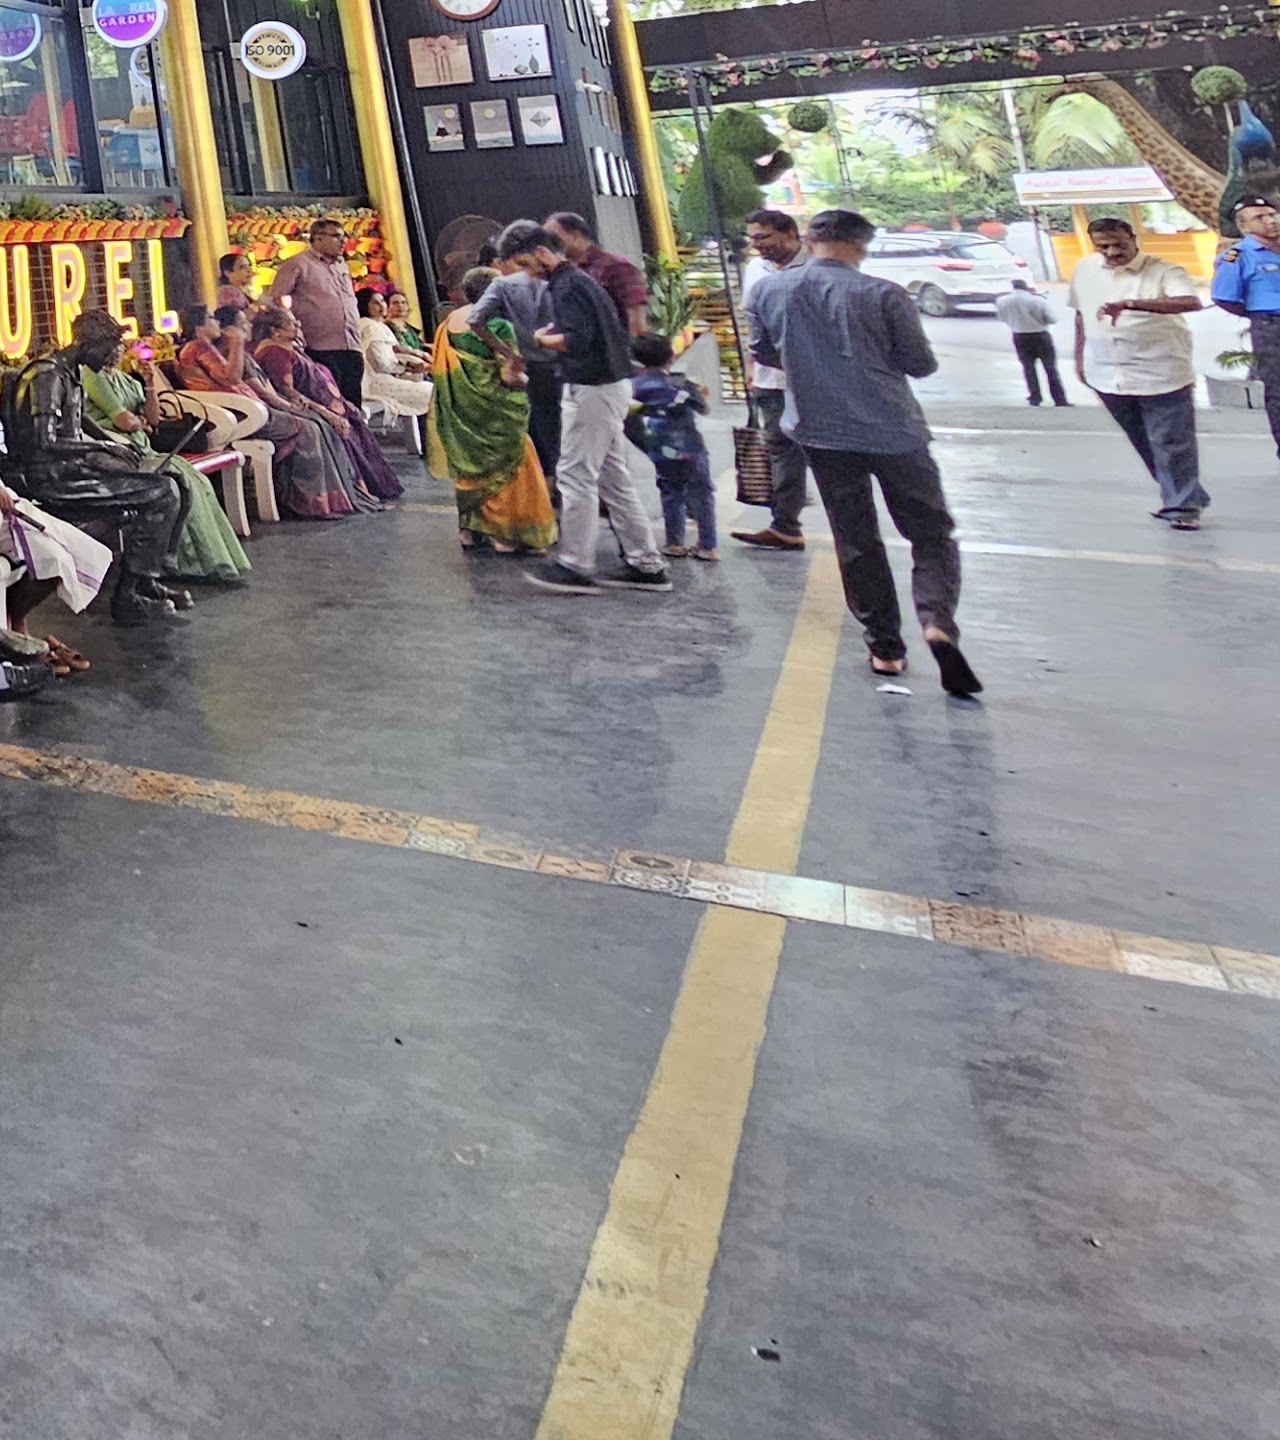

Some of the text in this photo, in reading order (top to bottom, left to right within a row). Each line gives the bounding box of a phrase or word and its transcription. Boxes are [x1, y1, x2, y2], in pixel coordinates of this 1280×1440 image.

[98, 13, 156, 27] GARDEN
[245, 44, 295, 57] ISO 9001
